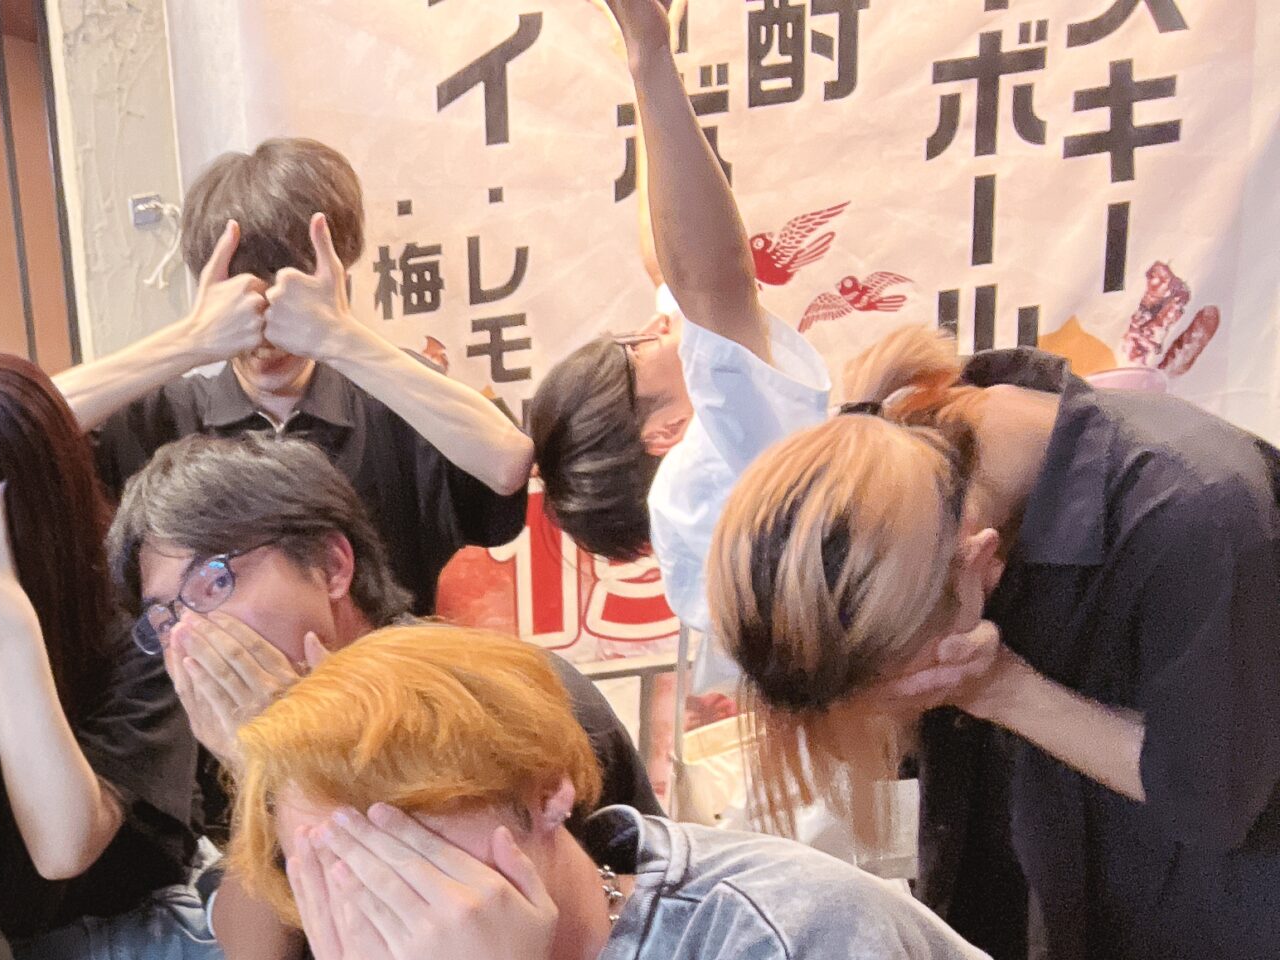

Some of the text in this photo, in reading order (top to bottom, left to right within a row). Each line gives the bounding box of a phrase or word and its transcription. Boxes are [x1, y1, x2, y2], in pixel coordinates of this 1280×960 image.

[427, 0, 543, 146] イ
[926, 0, 1049, 353] ボール
[466, 186, 533, 408] ・レモ
